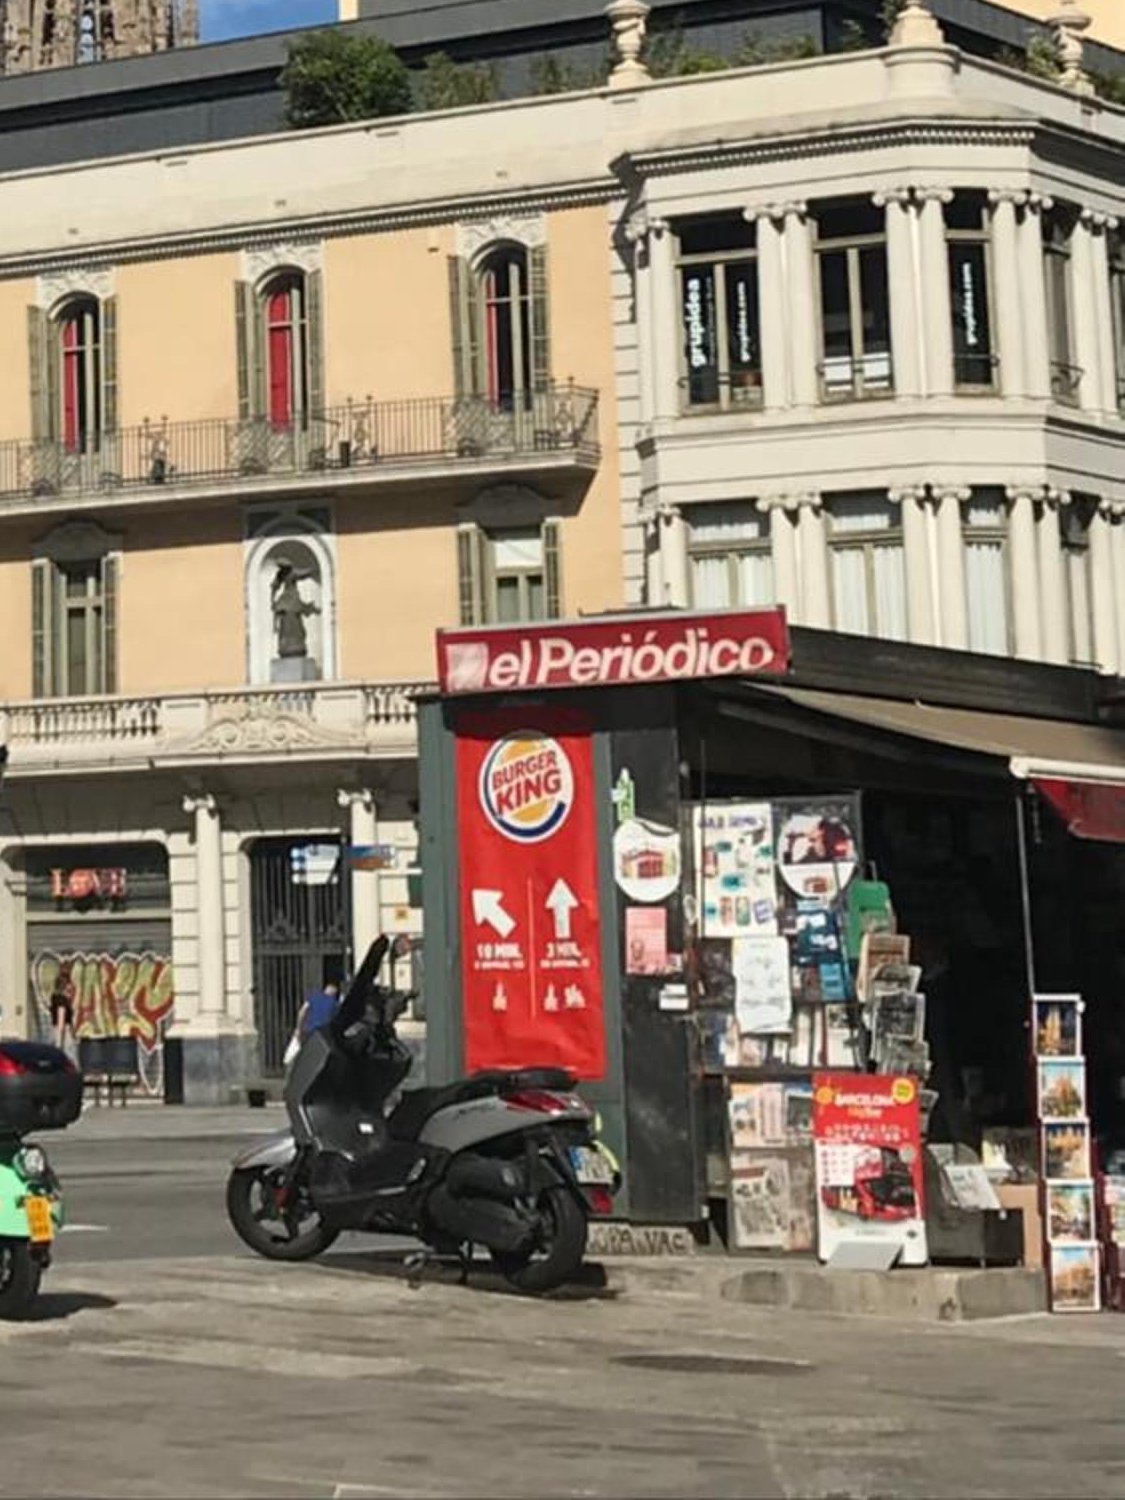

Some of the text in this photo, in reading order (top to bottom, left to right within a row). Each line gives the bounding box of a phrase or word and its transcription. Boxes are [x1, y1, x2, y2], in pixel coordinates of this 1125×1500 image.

[686, 278, 706, 368] grupidea
[738, 281, 750, 362] grupidea.com
[961, 262, 975, 346] grupidea.com
[489, 628, 773, 686] el Periódico
[492, 749, 557, 791] BURGER
[496, 769, 562, 815] KING
[51, 868, 127, 898] LOVE
